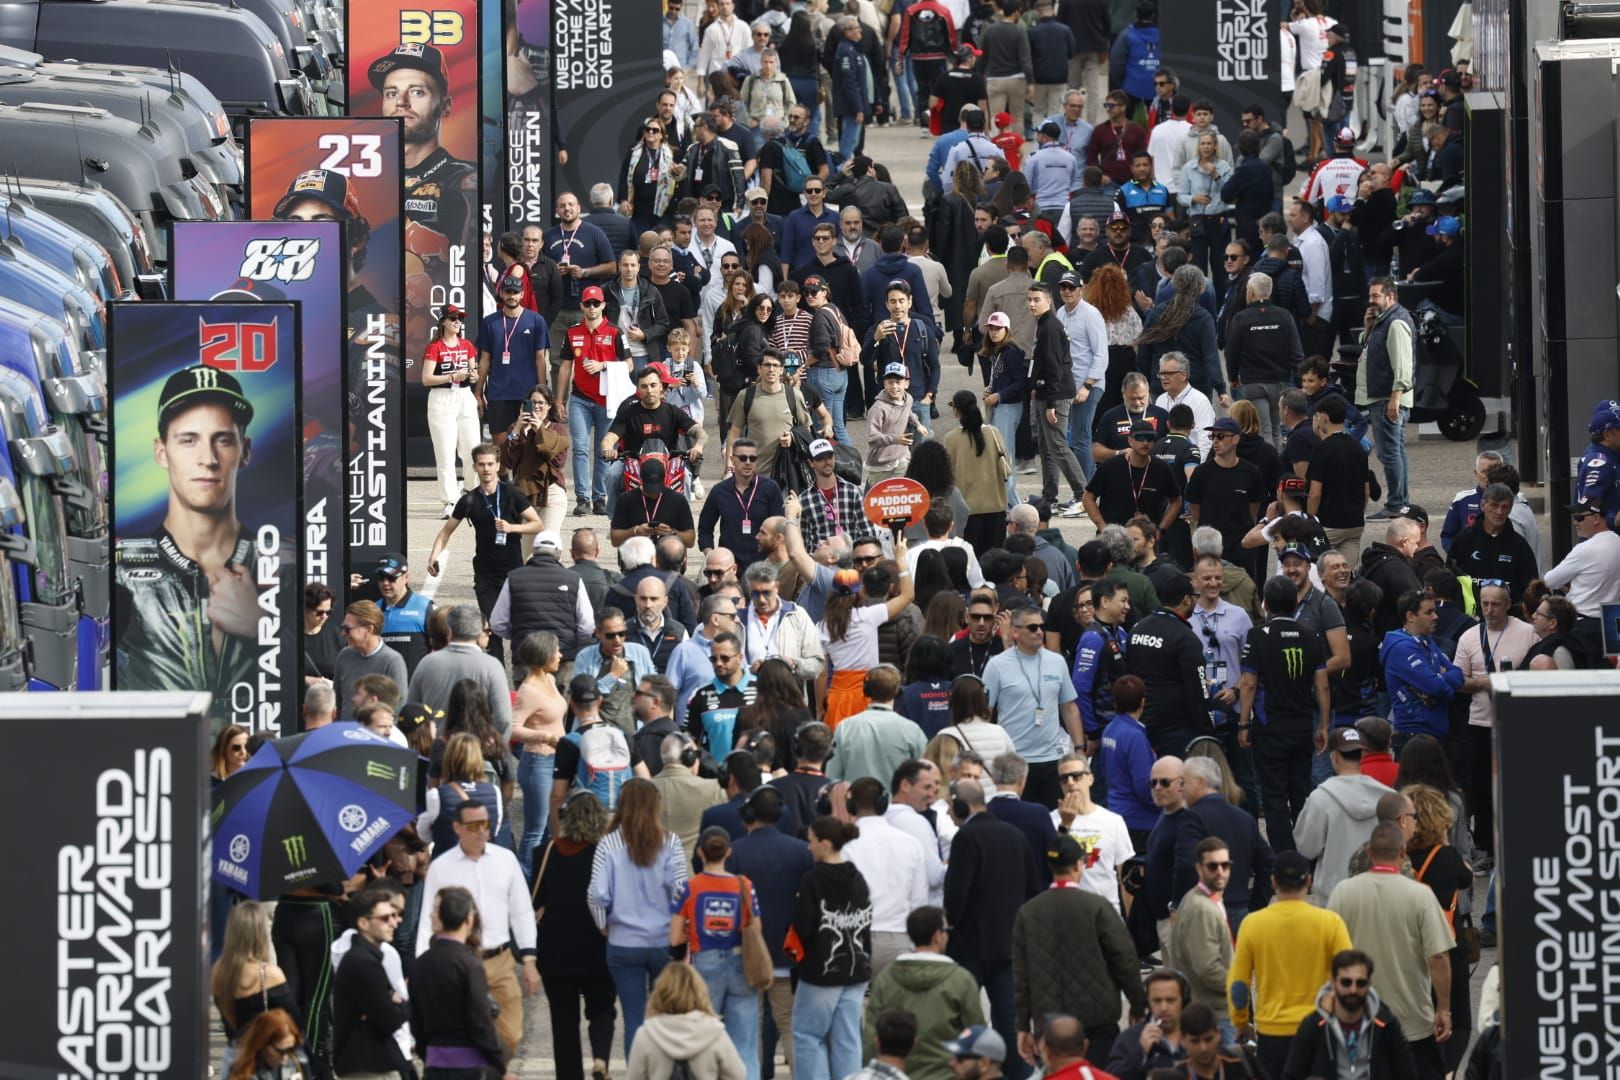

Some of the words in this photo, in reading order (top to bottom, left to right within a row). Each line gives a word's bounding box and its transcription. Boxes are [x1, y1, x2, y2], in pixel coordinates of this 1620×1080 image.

[570, 15, 583, 57] THE
[571, 61, 583, 89] TO
[600, 60, 613, 89] ON
[318, 134, 383, 178] 23
[509, 129, 524, 223] JORGE
[526, 111, 540, 222] MARTIN
[240, 237, 320, 284] 88
[199, 315, 279, 373] 20
[367, 313, 387, 546] BASTIANINI
[349, 451, 365, 547] ENEA
[870, 493, 923, 508] PADDOCK
[881, 504, 912, 517] TOUR
[127, 570, 158, 579] HJC
[160, 535, 191, 570] YAMAHA
[1131, 633, 1164, 649] ENEOS
[1595, 725, 1620, 881] SPORT
[350, 816, 391, 855] YAMAHA
[1563, 774, 1594, 923] MOST
[217, 858, 249, 883] YAMAHA
[96, 767, 133, 1080] ORWARD
[57, 844, 95, 1080] ASTER
[1568, 930, 1598, 1024] THE
